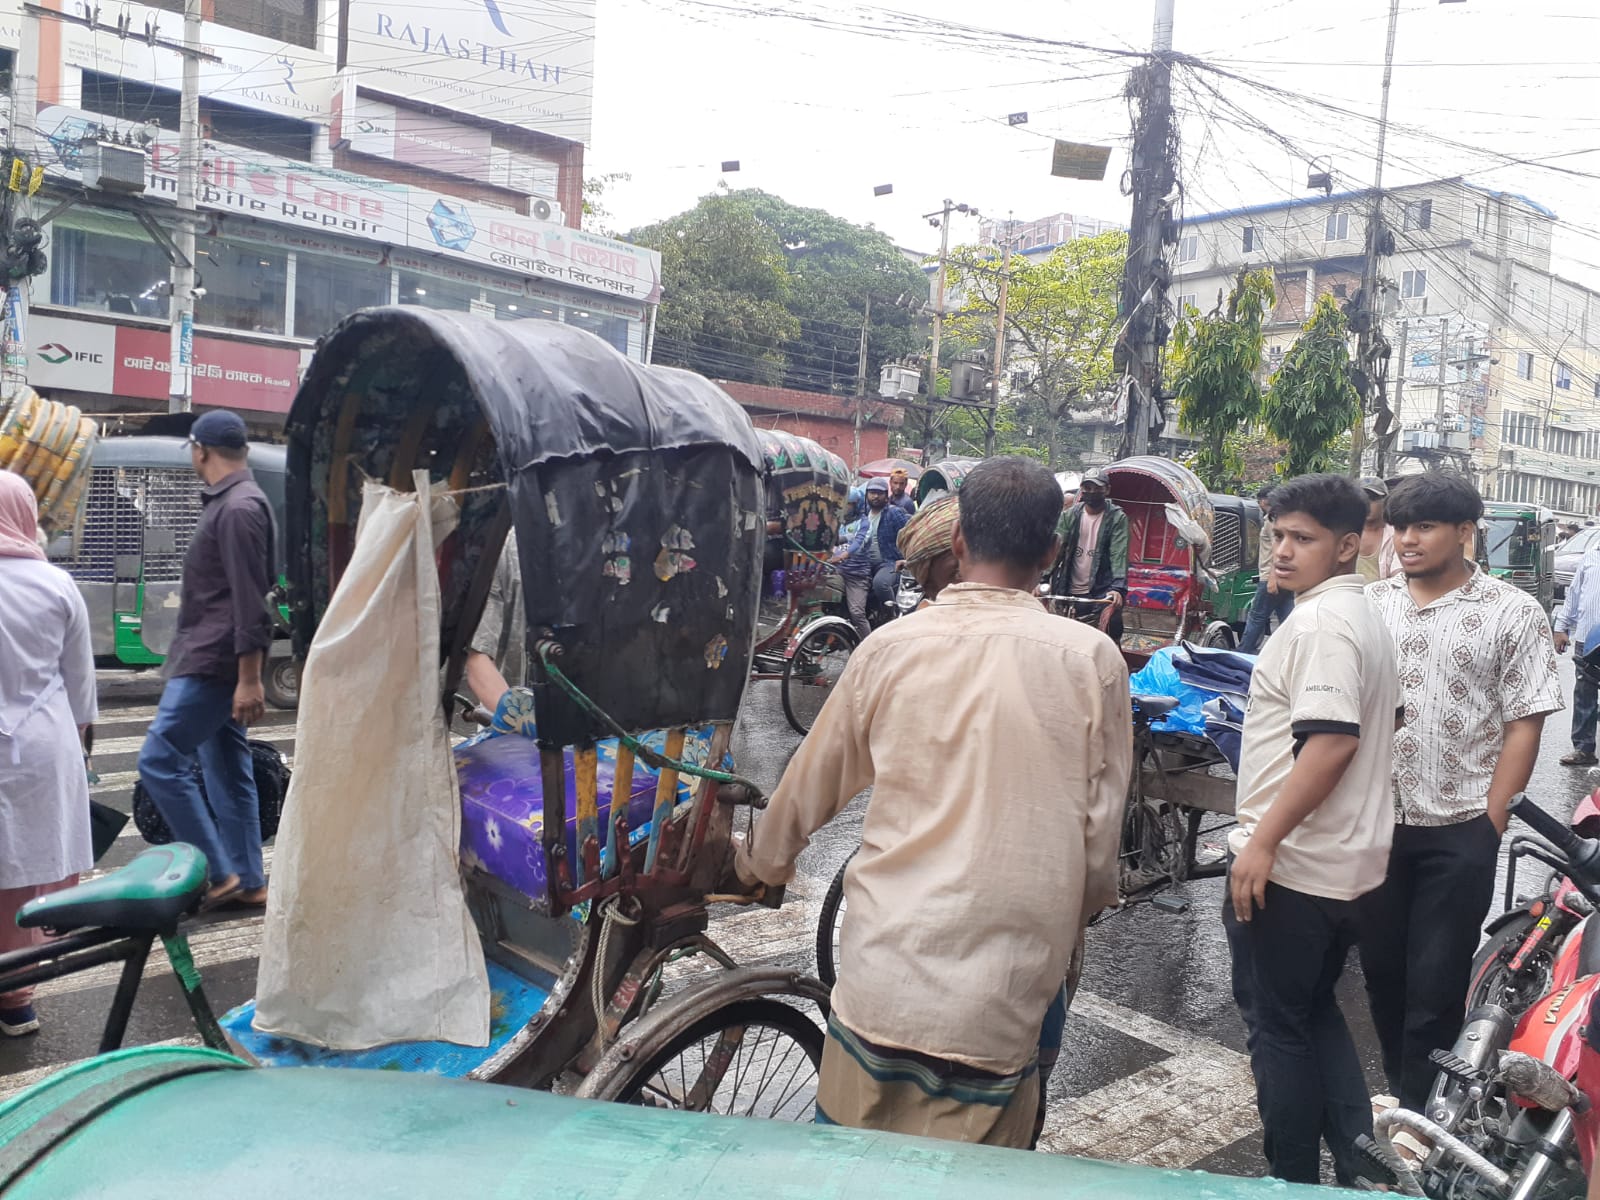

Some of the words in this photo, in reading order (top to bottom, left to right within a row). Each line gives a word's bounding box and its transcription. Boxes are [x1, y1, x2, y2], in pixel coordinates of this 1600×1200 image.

[376, 12, 562, 86] RAJASTHAN
[240, 86, 321, 114] RAJASTHAN
[152, 143, 237, 188] Cll
[286, 173, 384, 218] Care
[282, 202, 383, 234] Repair
[490, 250, 563, 278] মোবাইল
[569, 265, 636, 295] রিপেয়ার
[75, 351, 103, 364] IFIC
